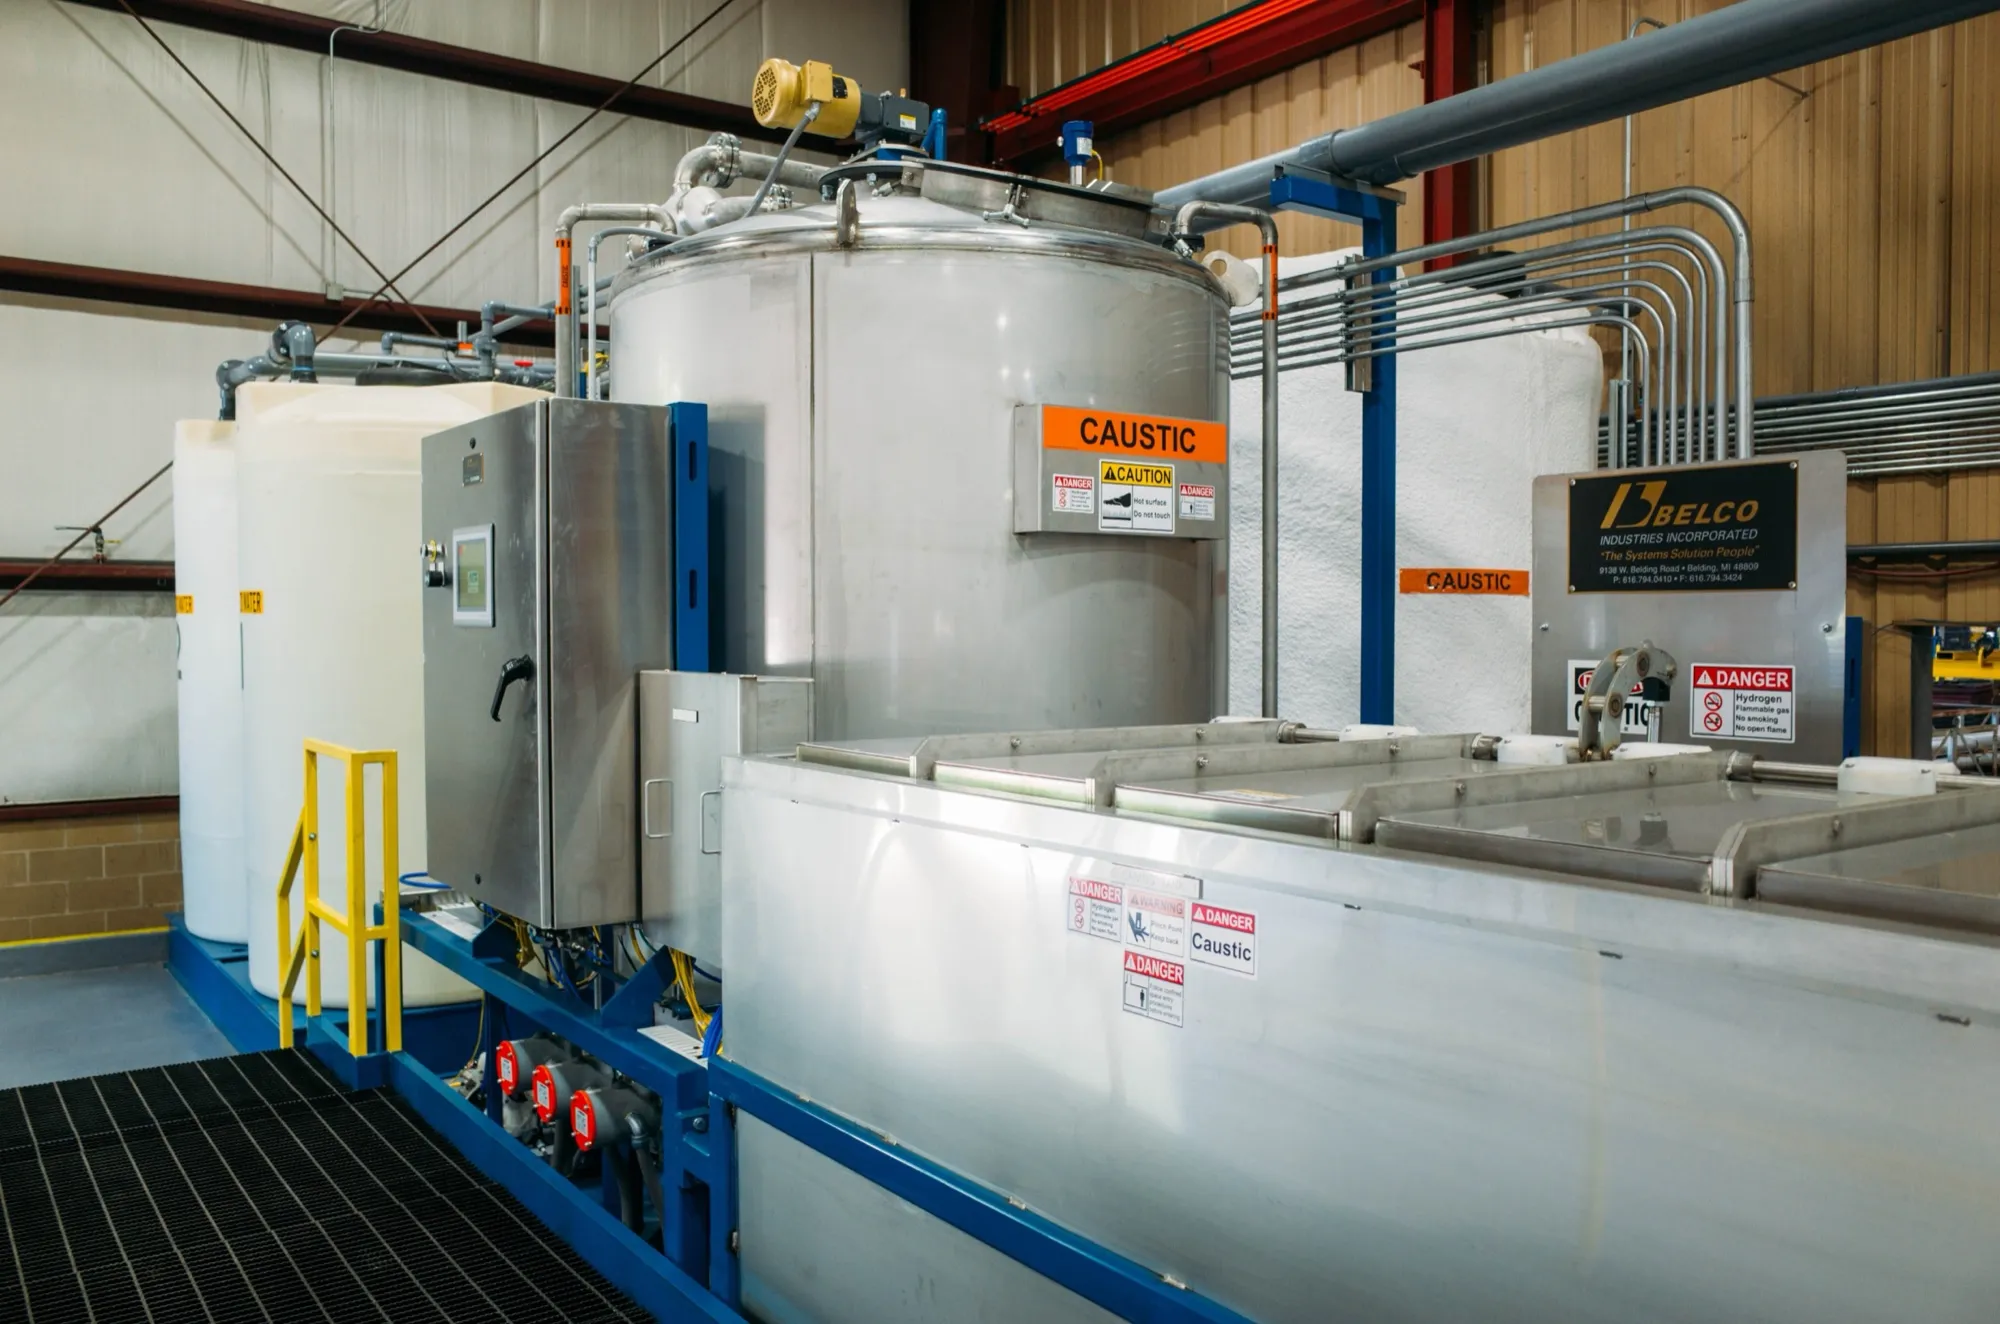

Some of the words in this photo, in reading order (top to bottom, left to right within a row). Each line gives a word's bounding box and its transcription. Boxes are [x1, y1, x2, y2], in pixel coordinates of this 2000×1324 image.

[1080, 417, 1196, 454] CAUSTIC
[1062, 478, 1092, 489] DANGER
[1118, 466, 1171, 485] CAUTION
[1187, 486, 1213, 497] DANGER
[1145, 498, 1167, 506] surface
[1133, 510, 1142, 518] Do
[1653, 500, 1759, 526] BELCO
[1600, 533, 1664, 546] INDUSTRIES
[1666, 528, 1758, 543] INCORPORATED
[1625, 550, 1669, 562] Systems
[1670, 547, 1714, 559] Solution
[1619, 566, 1629, 575] W.
[1630, 565, 1658, 575] Belding
[1659, 564, 1680, 573] Road
[1721, 563, 1731, 571] MI
[1426, 571, 1511, 590] CAUSTIC
[1716, 671, 1789, 688] DANGER
[1736, 693, 1782, 705] Hydrogen
[1735, 704, 1775, 713] Flammable
[1776, 707, 1790, 715] gas
[1747, 715, 1779, 725] smoking
[1766, 726, 1787, 734] flame
[1080, 881, 1121, 903] DANGER
[1140, 895, 1183, 915] WARNING
[1206, 910, 1253, 931] DANGER
[1192, 932, 1252, 961] Caustic
[1136, 957, 1184, 983] DANGER
